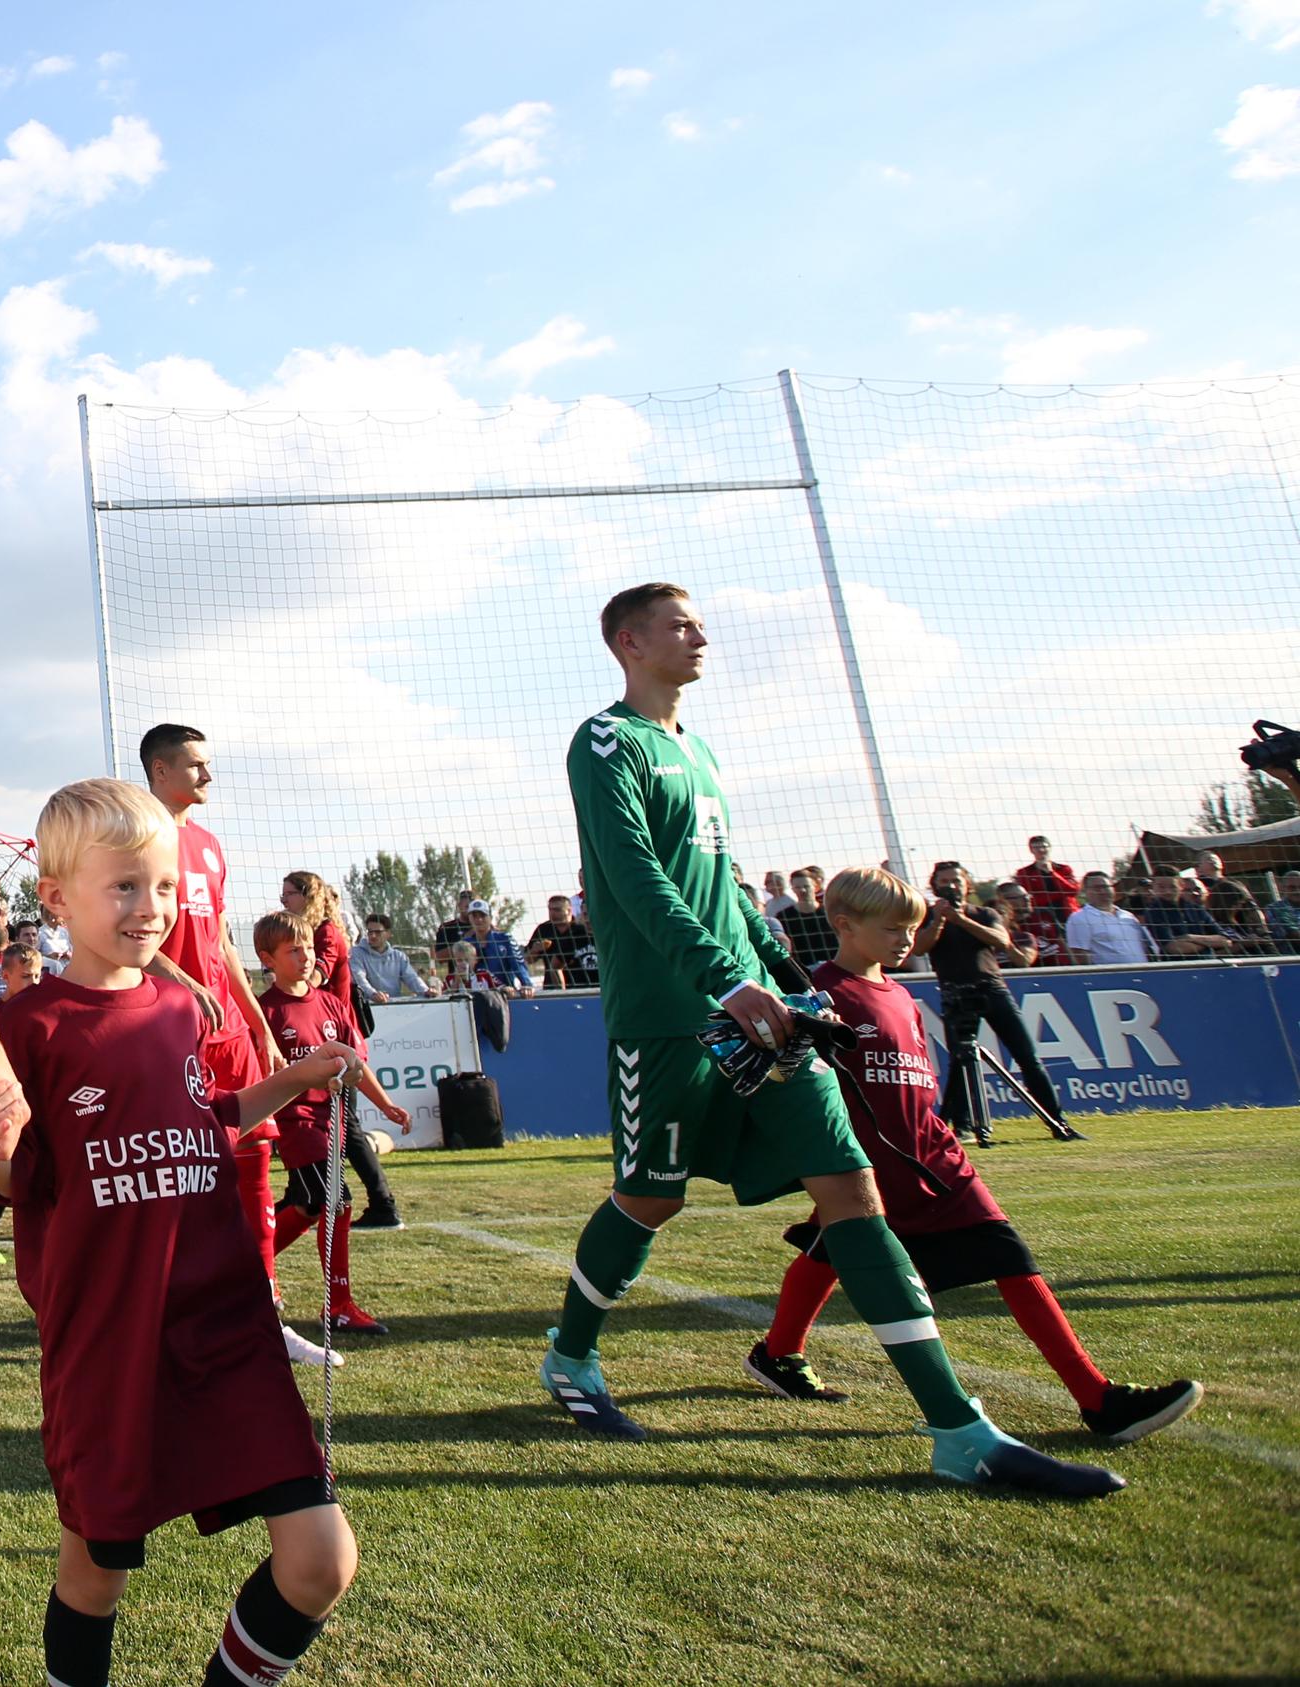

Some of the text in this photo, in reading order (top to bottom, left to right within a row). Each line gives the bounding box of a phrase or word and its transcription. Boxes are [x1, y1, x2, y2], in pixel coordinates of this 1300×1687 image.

[373, 1037, 448, 1054] Pyrbaum
[864, 1050, 932, 1073] FUSSBALL
[188, 1074, 206, 1097] FC
[865, 1068, 935, 1090] ERLEBNIS
[1067, 1074, 1191, 1104] Recycling
[75, 1103, 105, 1118] umbro
[85, 1127, 220, 1172] FUSSBALL
[665, 1122, 679, 1166] 1
[91, 1164, 219, 1208] ERLEBNIS
